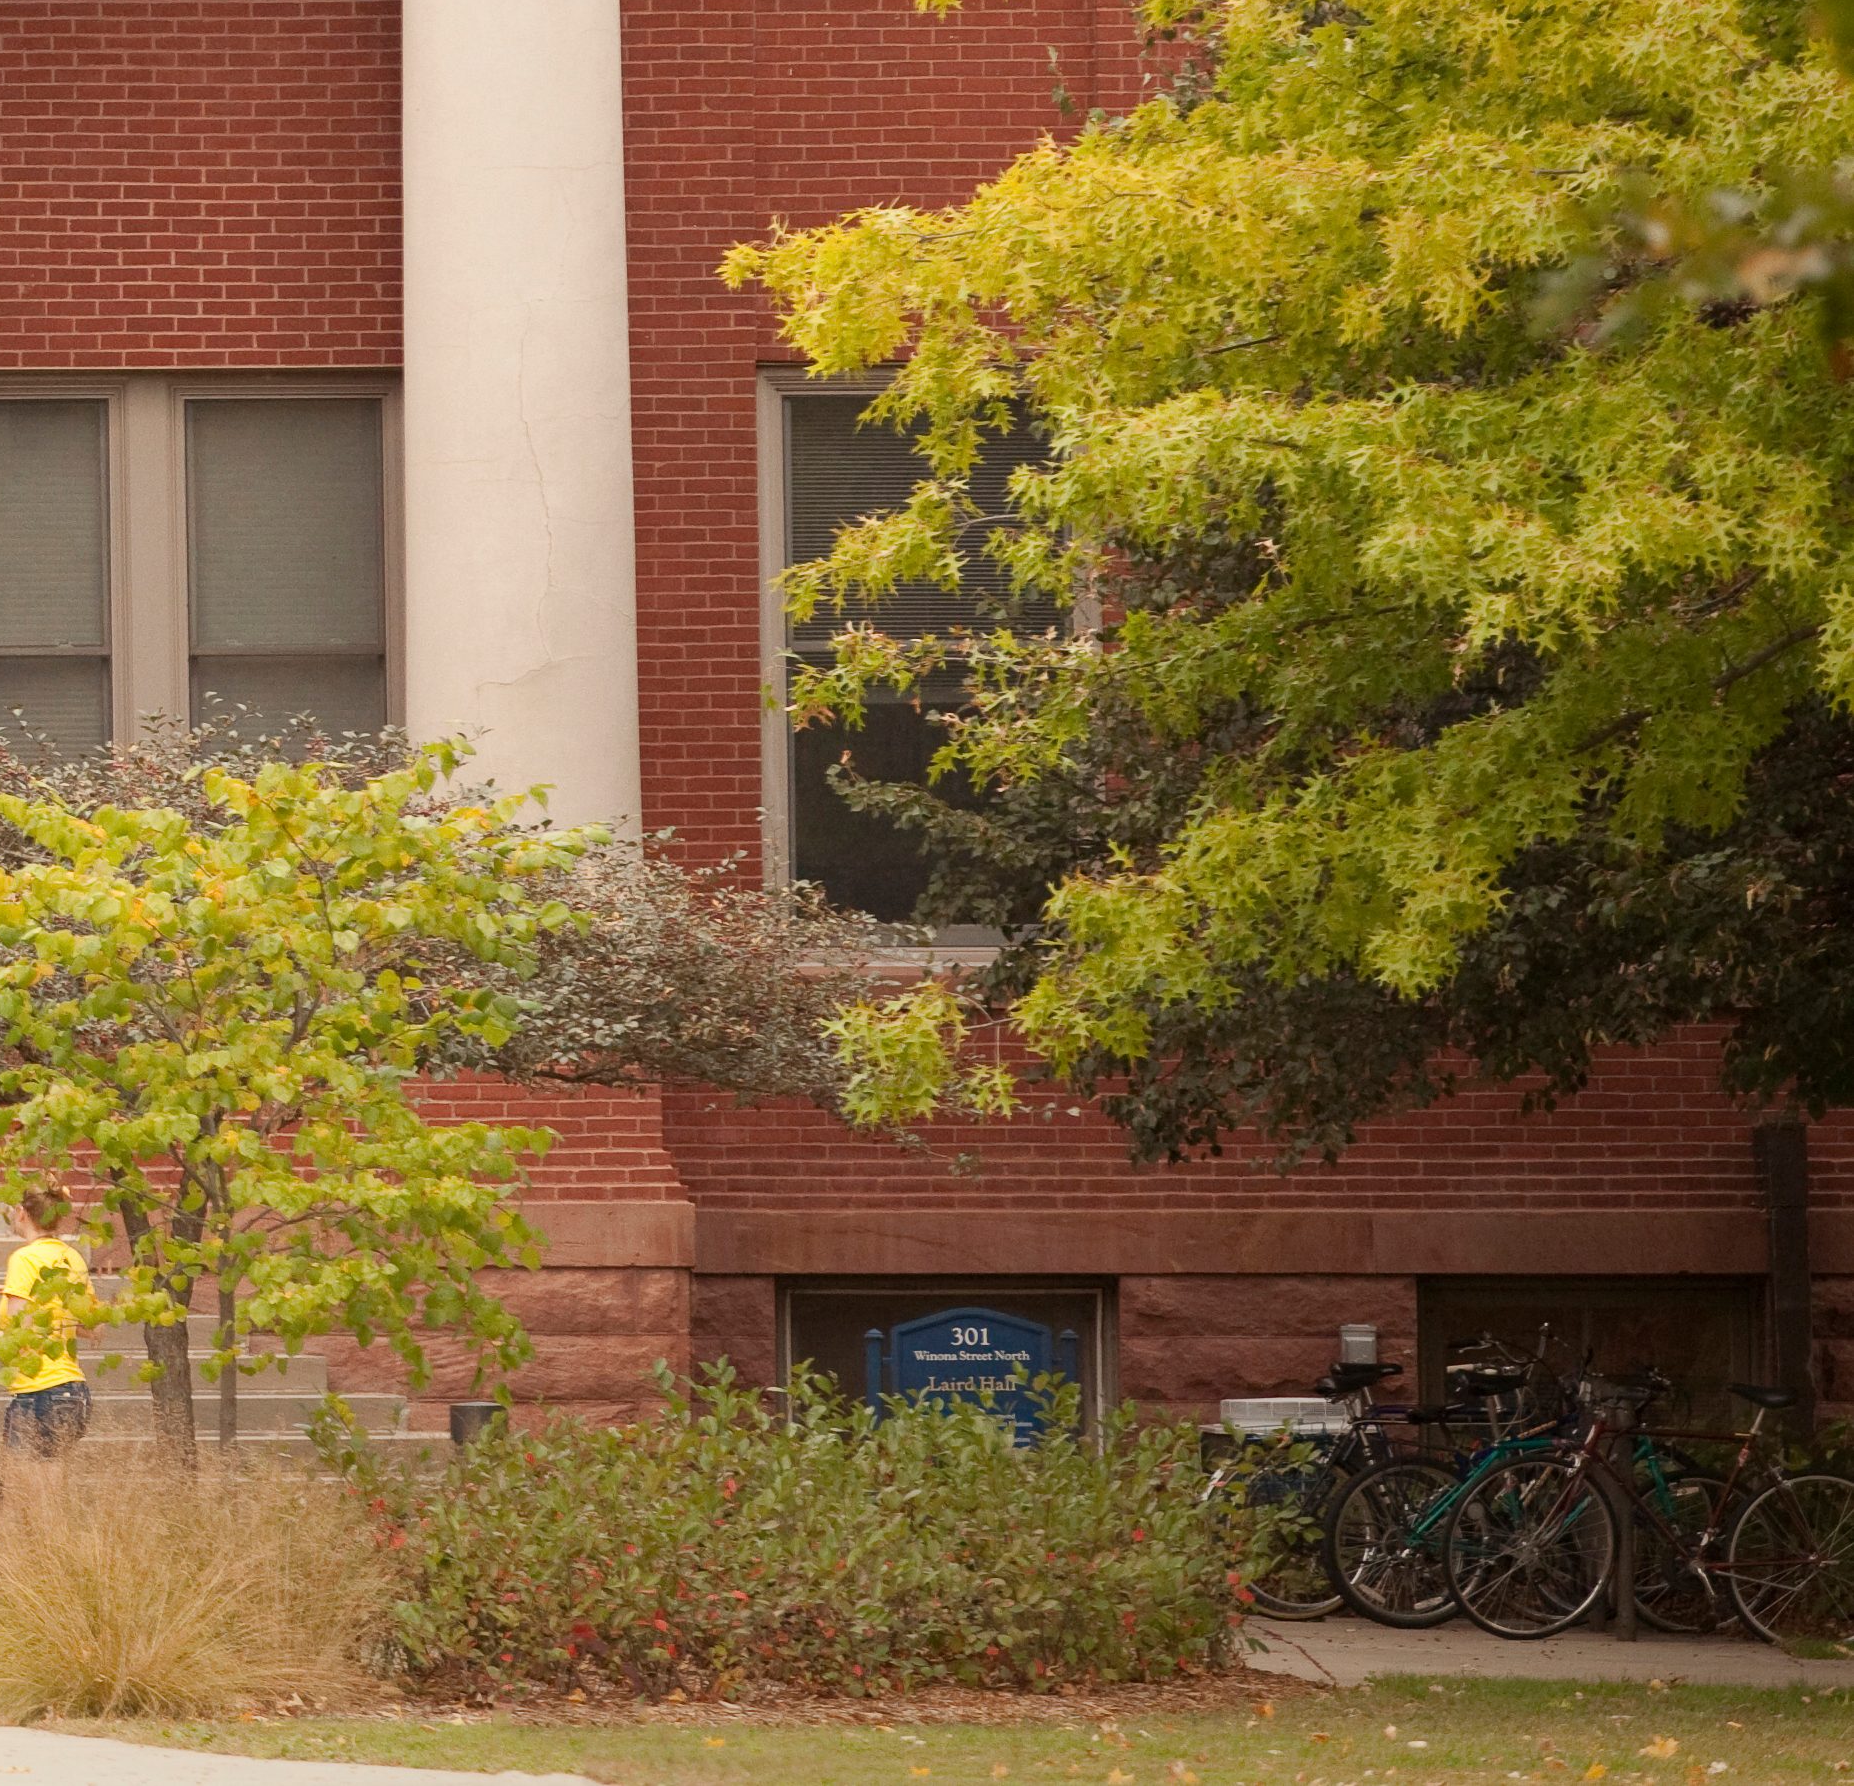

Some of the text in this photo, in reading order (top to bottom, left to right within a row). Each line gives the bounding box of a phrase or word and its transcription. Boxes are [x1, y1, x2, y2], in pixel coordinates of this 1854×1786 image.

[950, 1326, 991, 1346] 301
[912, 1349, 1031, 1361] Winona Street North
[928, 1375, 975, 1392] Laird
